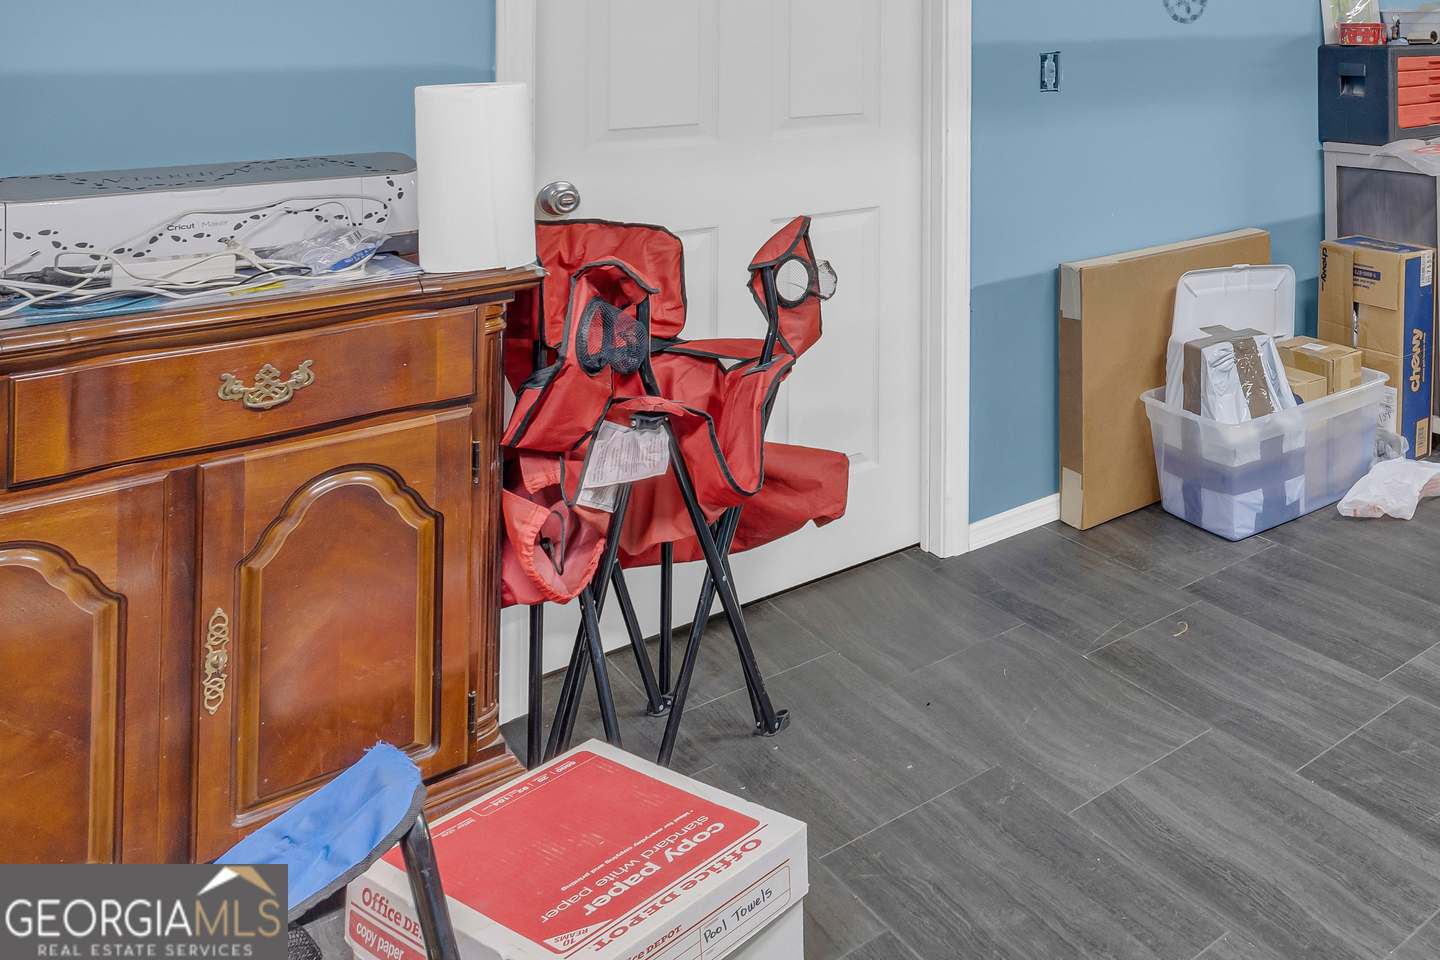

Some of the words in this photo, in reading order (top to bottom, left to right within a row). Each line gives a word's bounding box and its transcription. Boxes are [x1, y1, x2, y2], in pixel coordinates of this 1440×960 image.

[166, 223, 195, 231] Cricut
[202, 220, 228, 228] Maker
[1409, 328, 1424, 393] chewy
[604, 846, 633, 865] copying
[633, 827, 664, 848] everyday
[640, 815, 709, 860] standard
[664, 822, 725, 863] copy
[560, 872, 591, 891] printing
[590, 863, 605, 874] and
[595, 859, 641, 887] white
[680, 838, 762, 891] Office
[361, 887, 402, 927] Office
[540, 886, 594, 923] paper
[583, 861, 662, 916] paper
[594, 891, 682, 952] DEPOT
[703, 919, 727, 943] Pool
[731, 887, 773, 922] Towels
[356, 922, 378, 948] copy
[377, 936, 405, 960] paper
[554, 928, 589, 943] REAMS
[562, 937, 576, 946] 10
[645, 924, 683, 955] DEPOT
